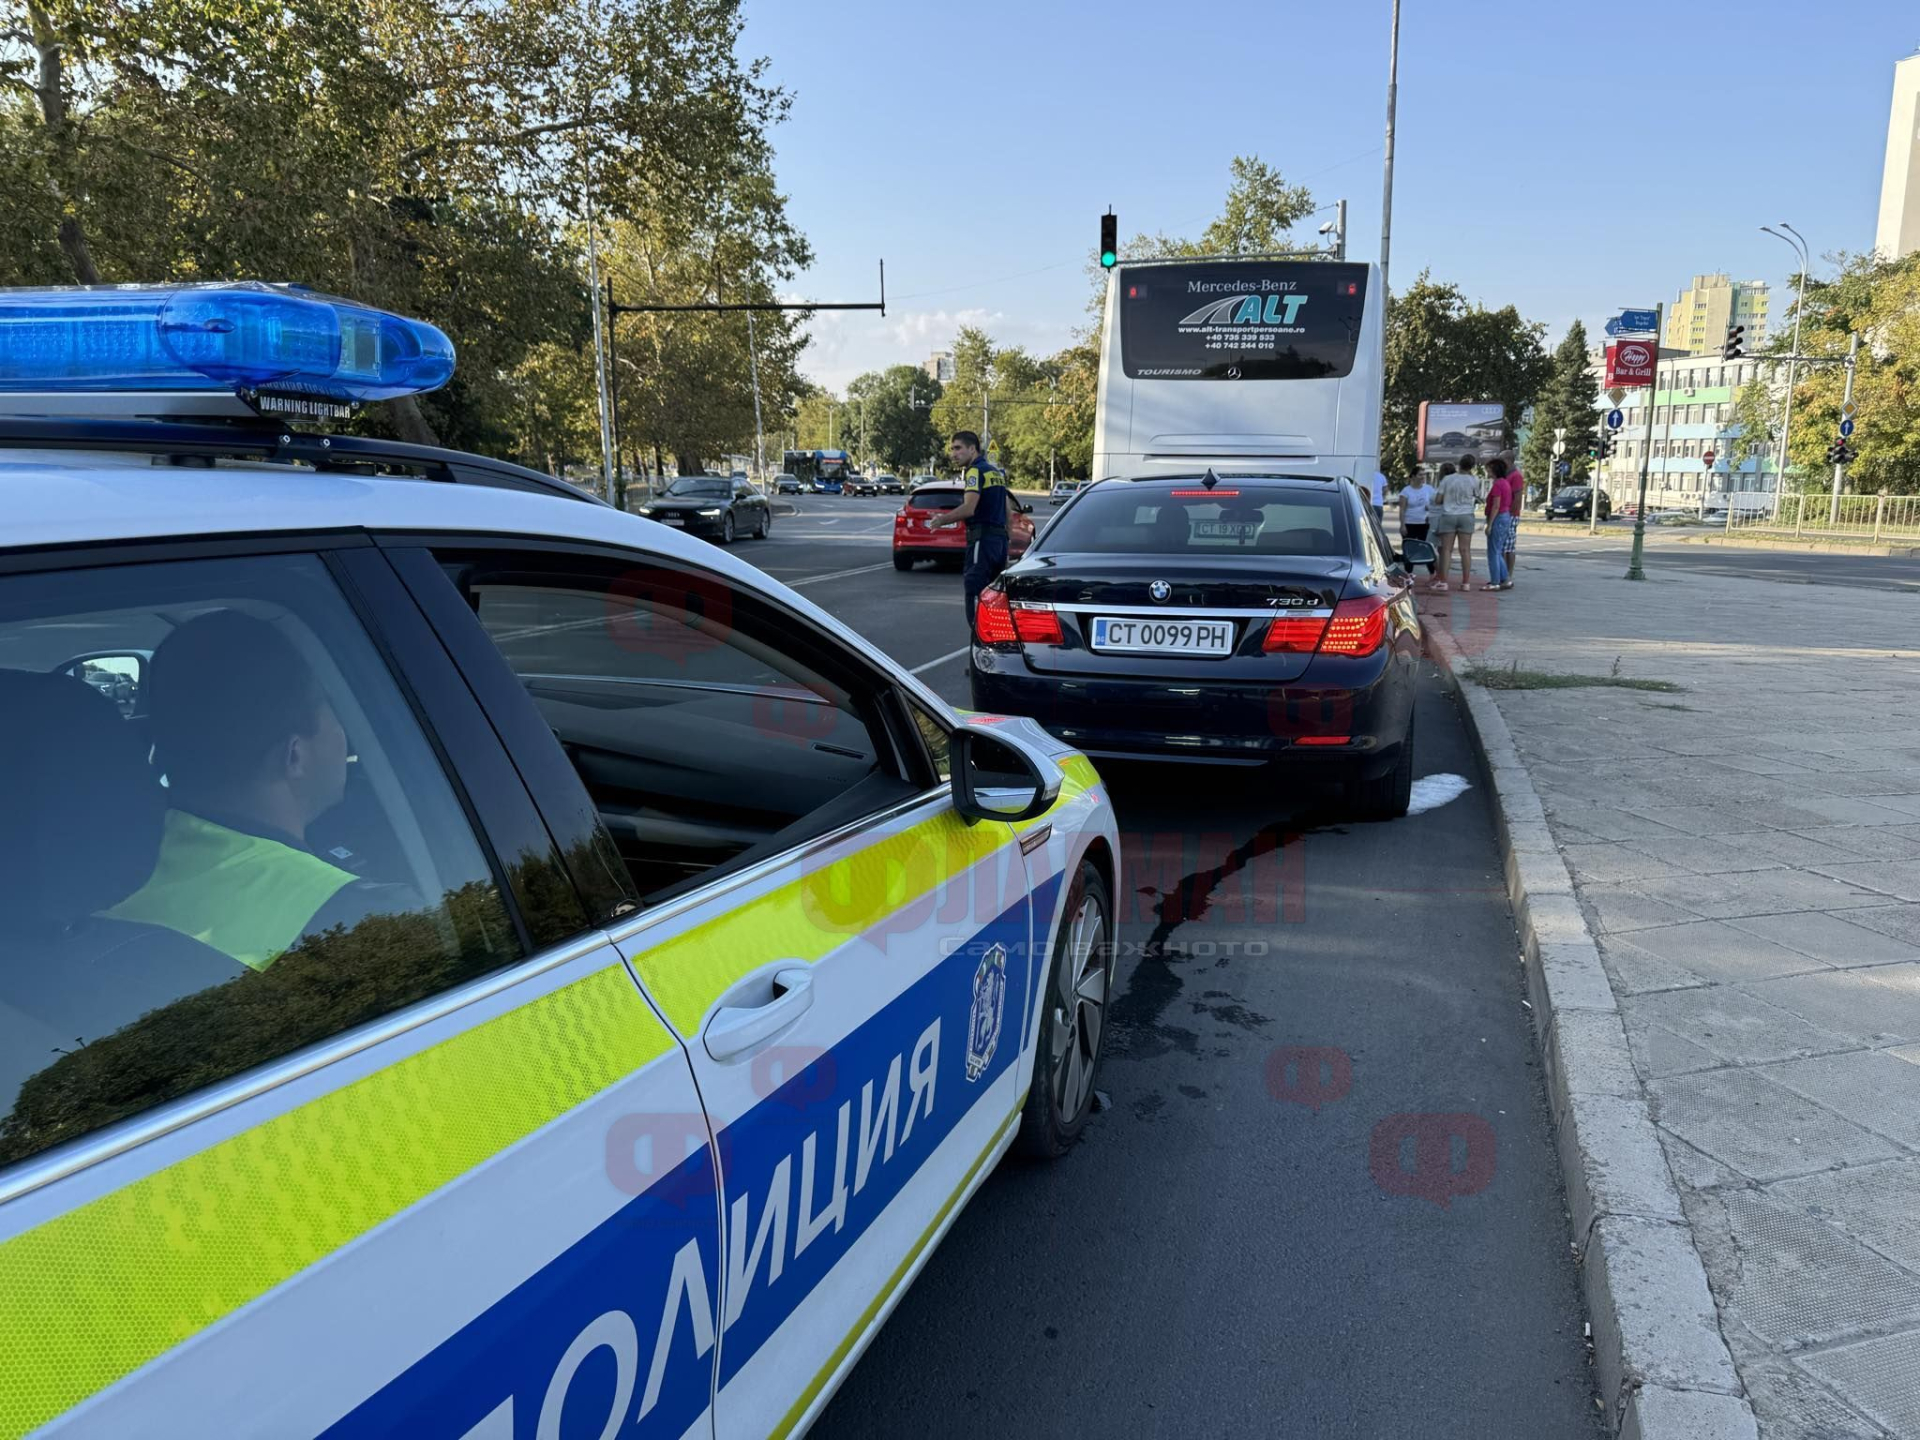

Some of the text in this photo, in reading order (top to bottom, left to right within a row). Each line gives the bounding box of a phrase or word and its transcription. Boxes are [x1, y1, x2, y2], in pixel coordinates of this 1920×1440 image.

[1187, 280, 1297, 293] Mercedes-Benz
[1233, 294, 1308, 324] ALT
[1178, 326, 1306, 335] www.alt-transportpersoane.ro
[1205, 334, 1222, 342] +40
[1204, 342, 1275, 350] +40 742 244 010
[1137, 368, 1202, 376] TOURISMO
[1615, 367, 1628, 376] Bar
[1628, 368, 1634, 376] &
[1635, 368, 1652, 377] Grill
[260, 396, 351, 419] WARNING LIGHTBAR
[1108, 623, 1225, 648] CT 0099 PH
[458, 1016, 942, 1440] ОЛИЦИЯ
